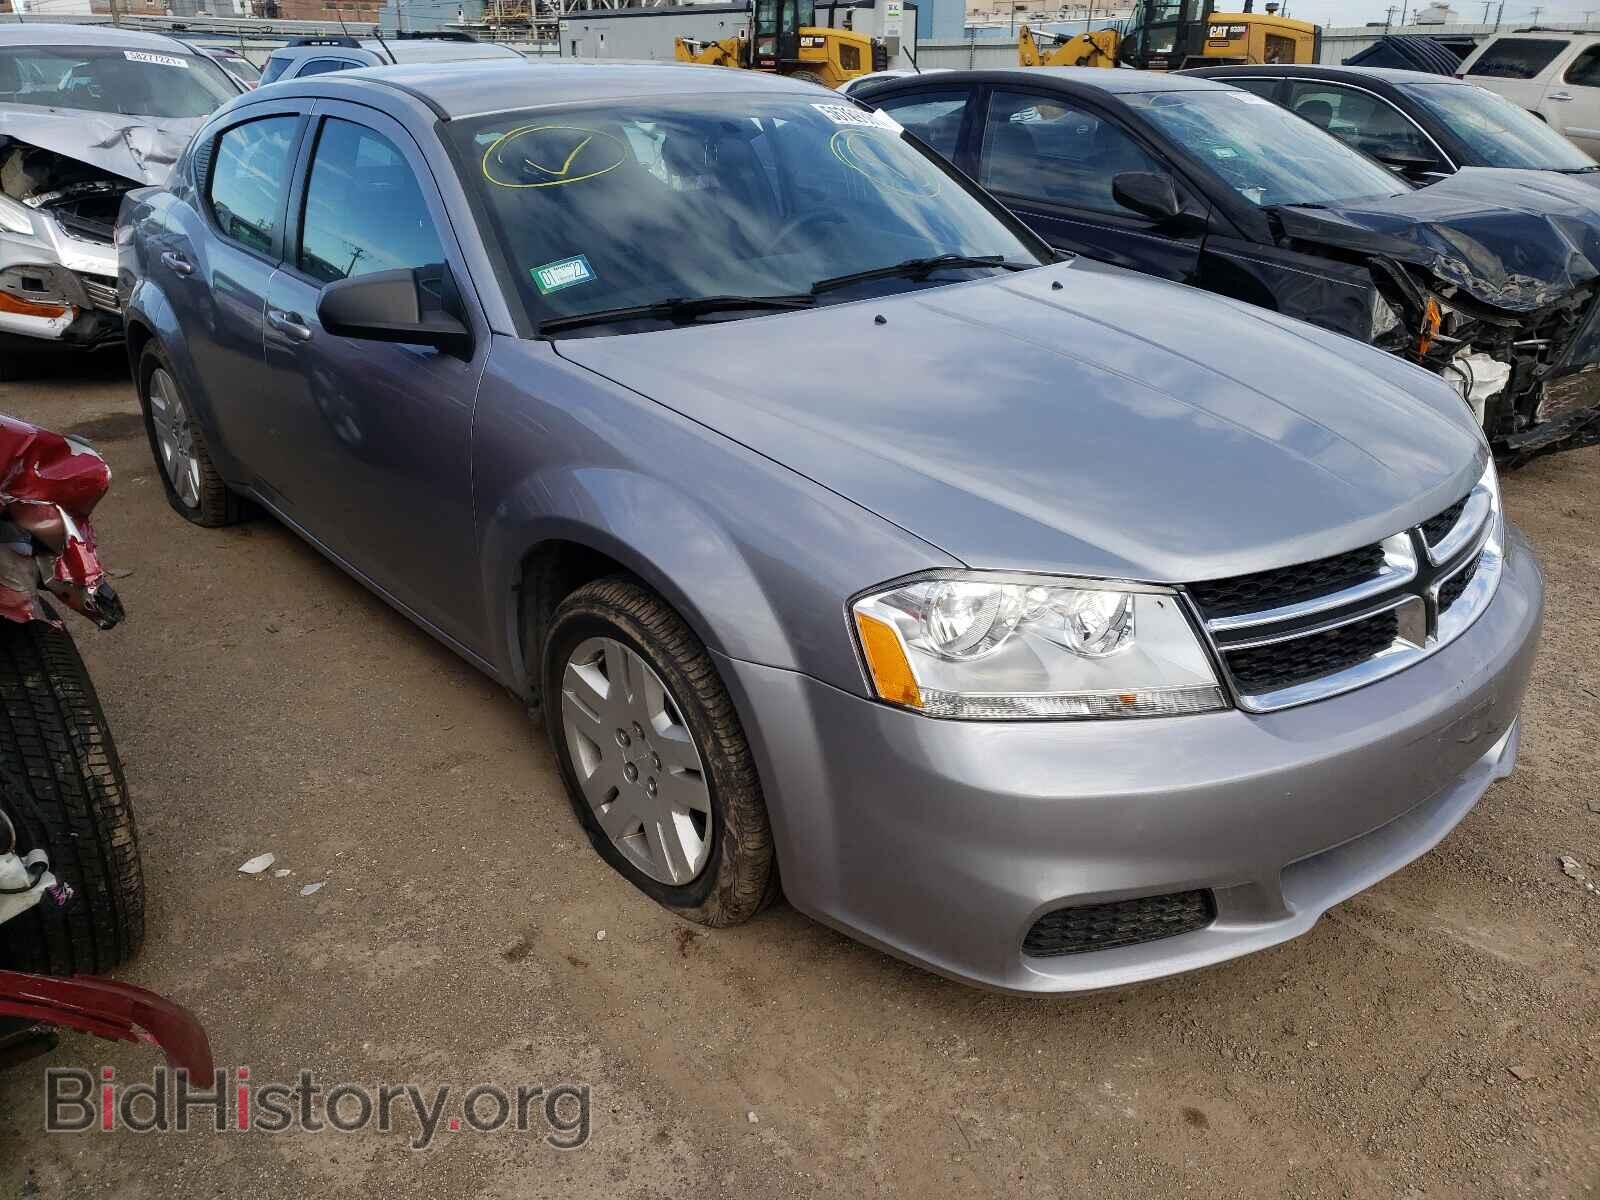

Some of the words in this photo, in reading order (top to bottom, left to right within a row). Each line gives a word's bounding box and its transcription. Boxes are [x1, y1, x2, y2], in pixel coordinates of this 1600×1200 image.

[1209, 25, 1229, 38] CAT
[800, 36, 814, 47] CAT
[541, 269, 557, 286] 01
[570, 261, 587, 278] 22
